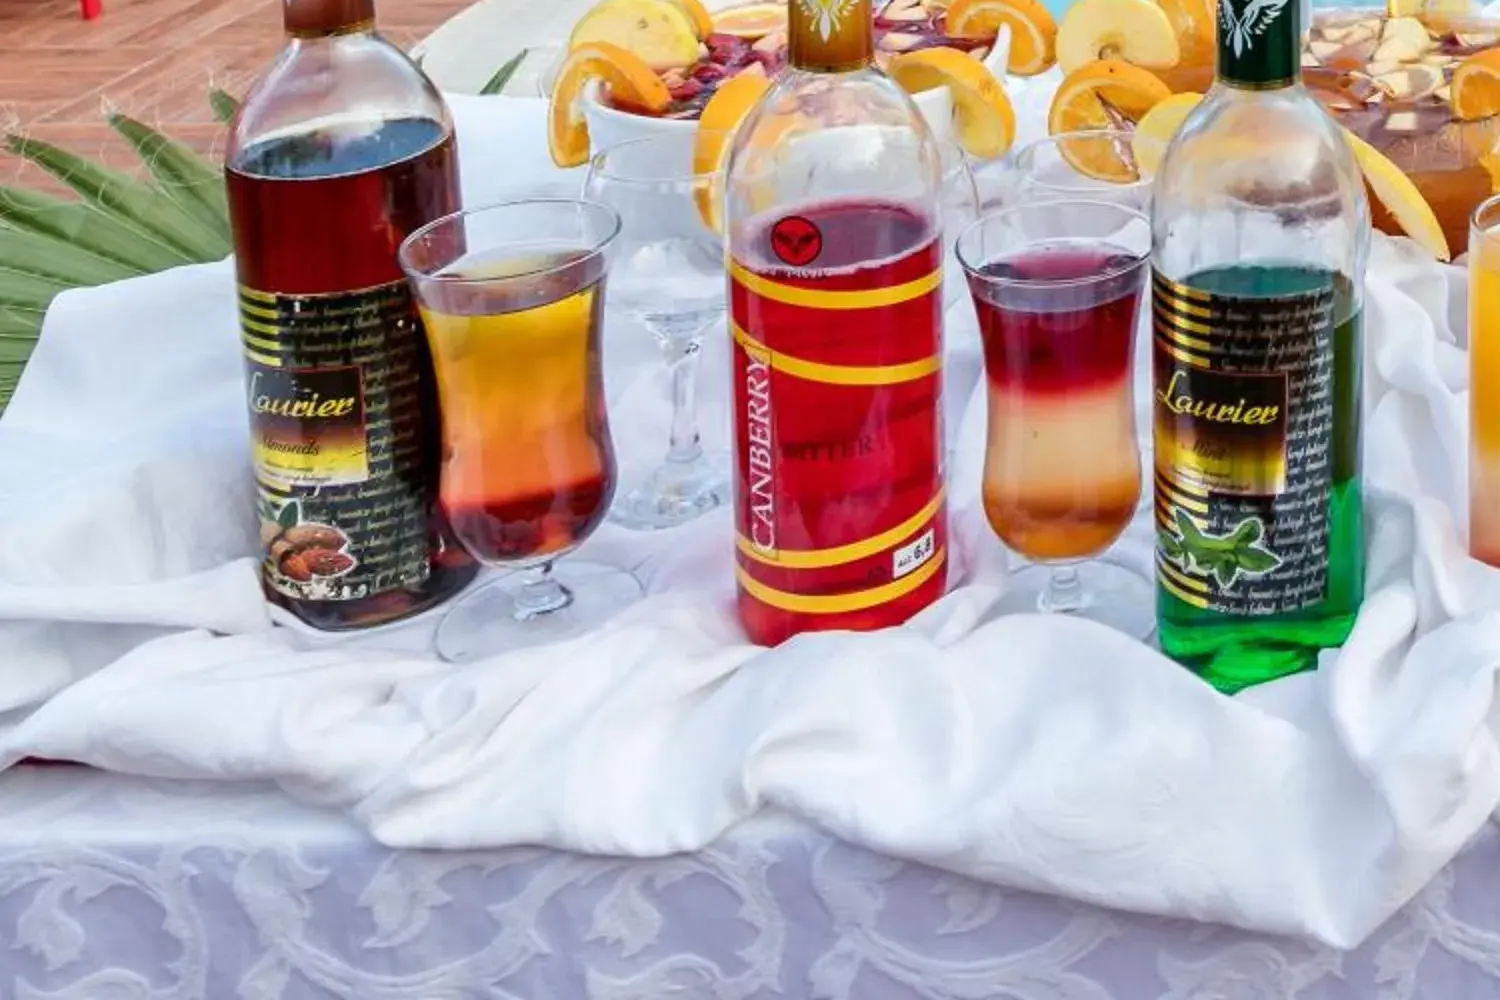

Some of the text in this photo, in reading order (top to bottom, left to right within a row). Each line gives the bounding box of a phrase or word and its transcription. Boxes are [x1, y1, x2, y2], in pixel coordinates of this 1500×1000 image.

[248, 371, 355, 417] Laurier
[1155, 369, 1279, 425] Laurier
[747, 360, 775, 551] CANBERRY
